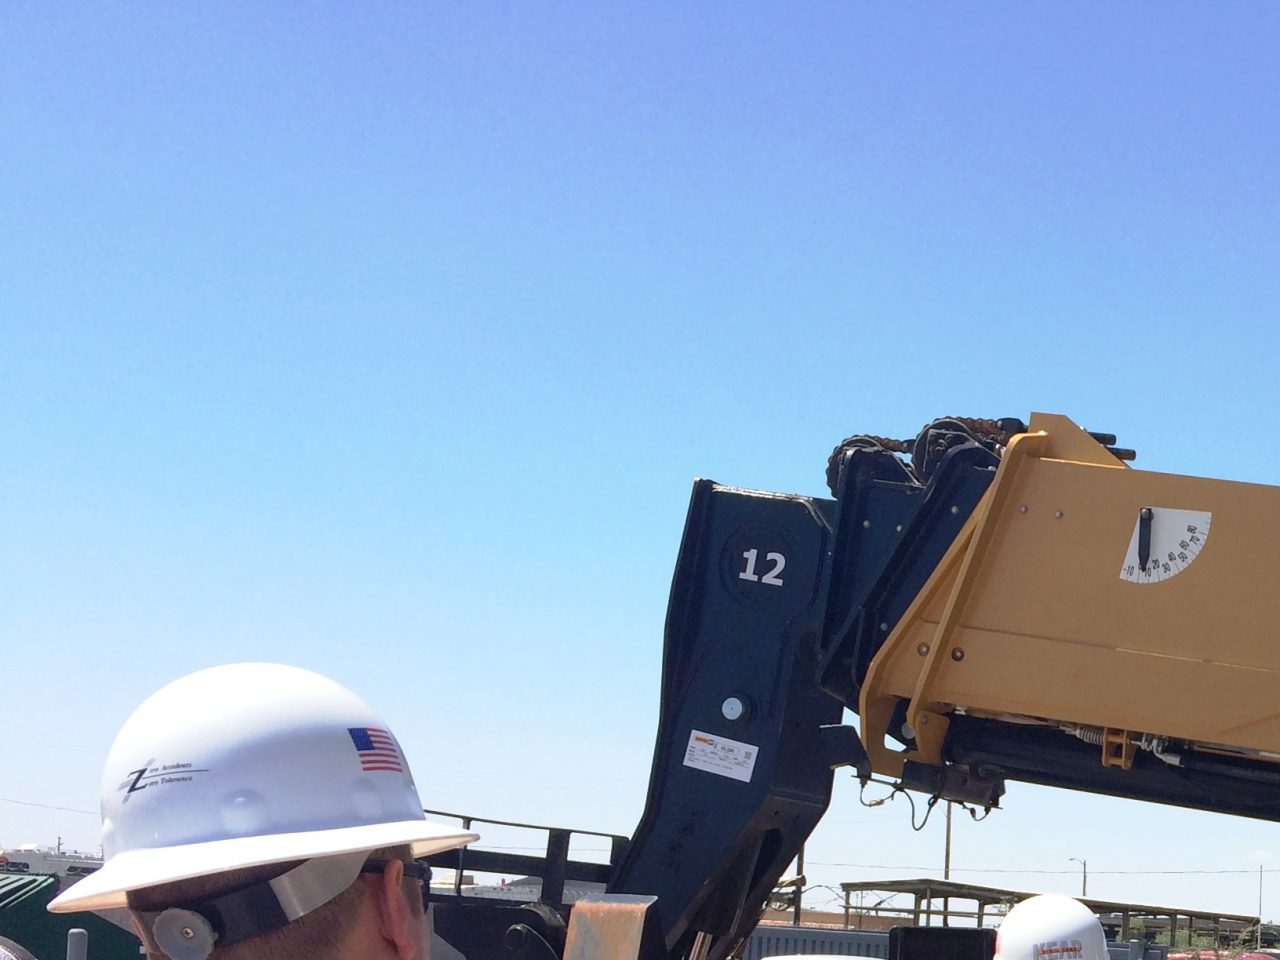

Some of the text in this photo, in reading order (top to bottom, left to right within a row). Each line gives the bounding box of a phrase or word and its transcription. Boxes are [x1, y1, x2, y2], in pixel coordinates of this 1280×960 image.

[739, 548, 786, 586] 12
[1152, 558, 1161, 570] 20
[1162, 562, 1171, 574] 30
[1167, 551, 1177, 562] 40
[1177, 551, 1189, 563] 50
[1189, 534, 1201, 546] 70
